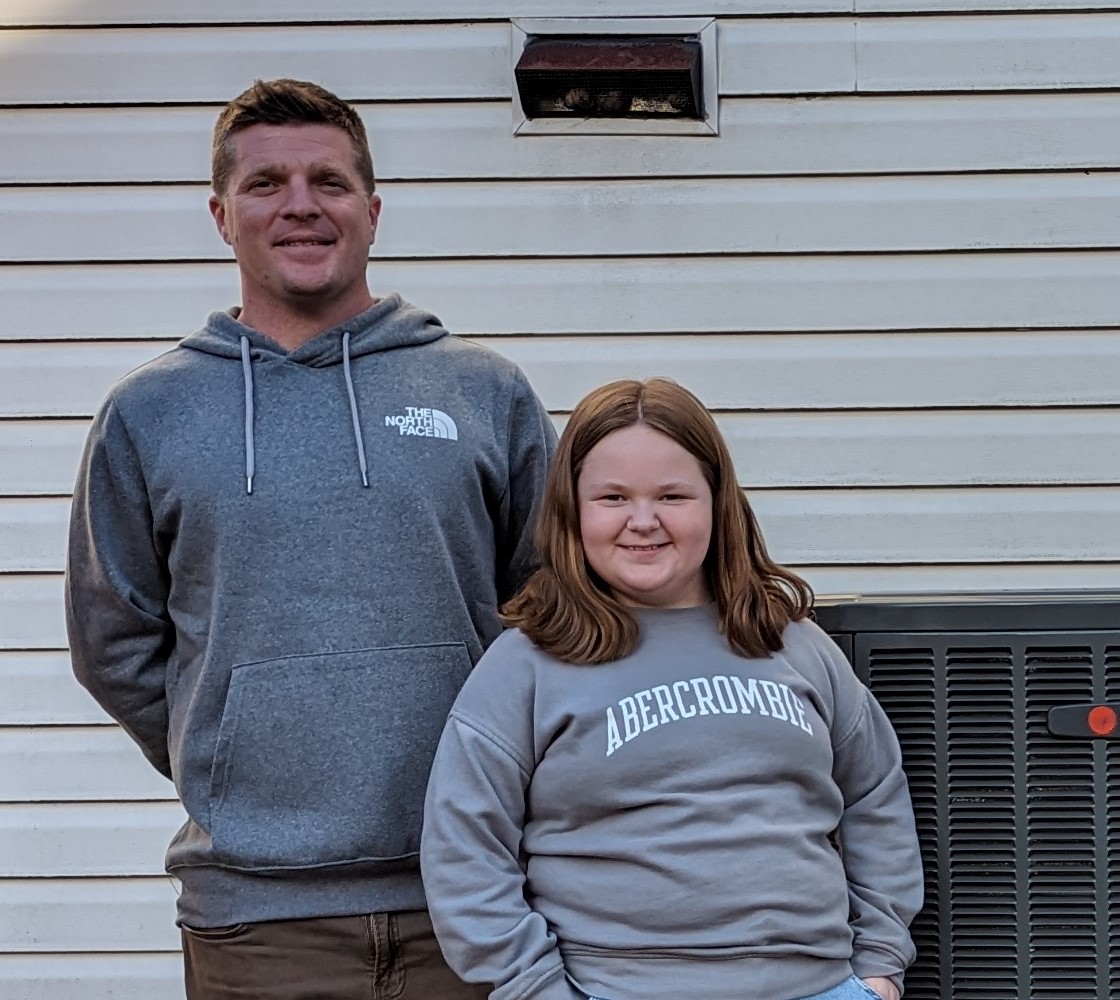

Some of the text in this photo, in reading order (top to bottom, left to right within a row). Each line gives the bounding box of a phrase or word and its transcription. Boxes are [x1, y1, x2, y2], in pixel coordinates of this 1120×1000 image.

[404, 406, 432, 418] THE
[384, 415, 434, 427] NORTH
[399, 424, 434, 437] FACE
[606, 675, 814, 757] ABERCROMBIE
